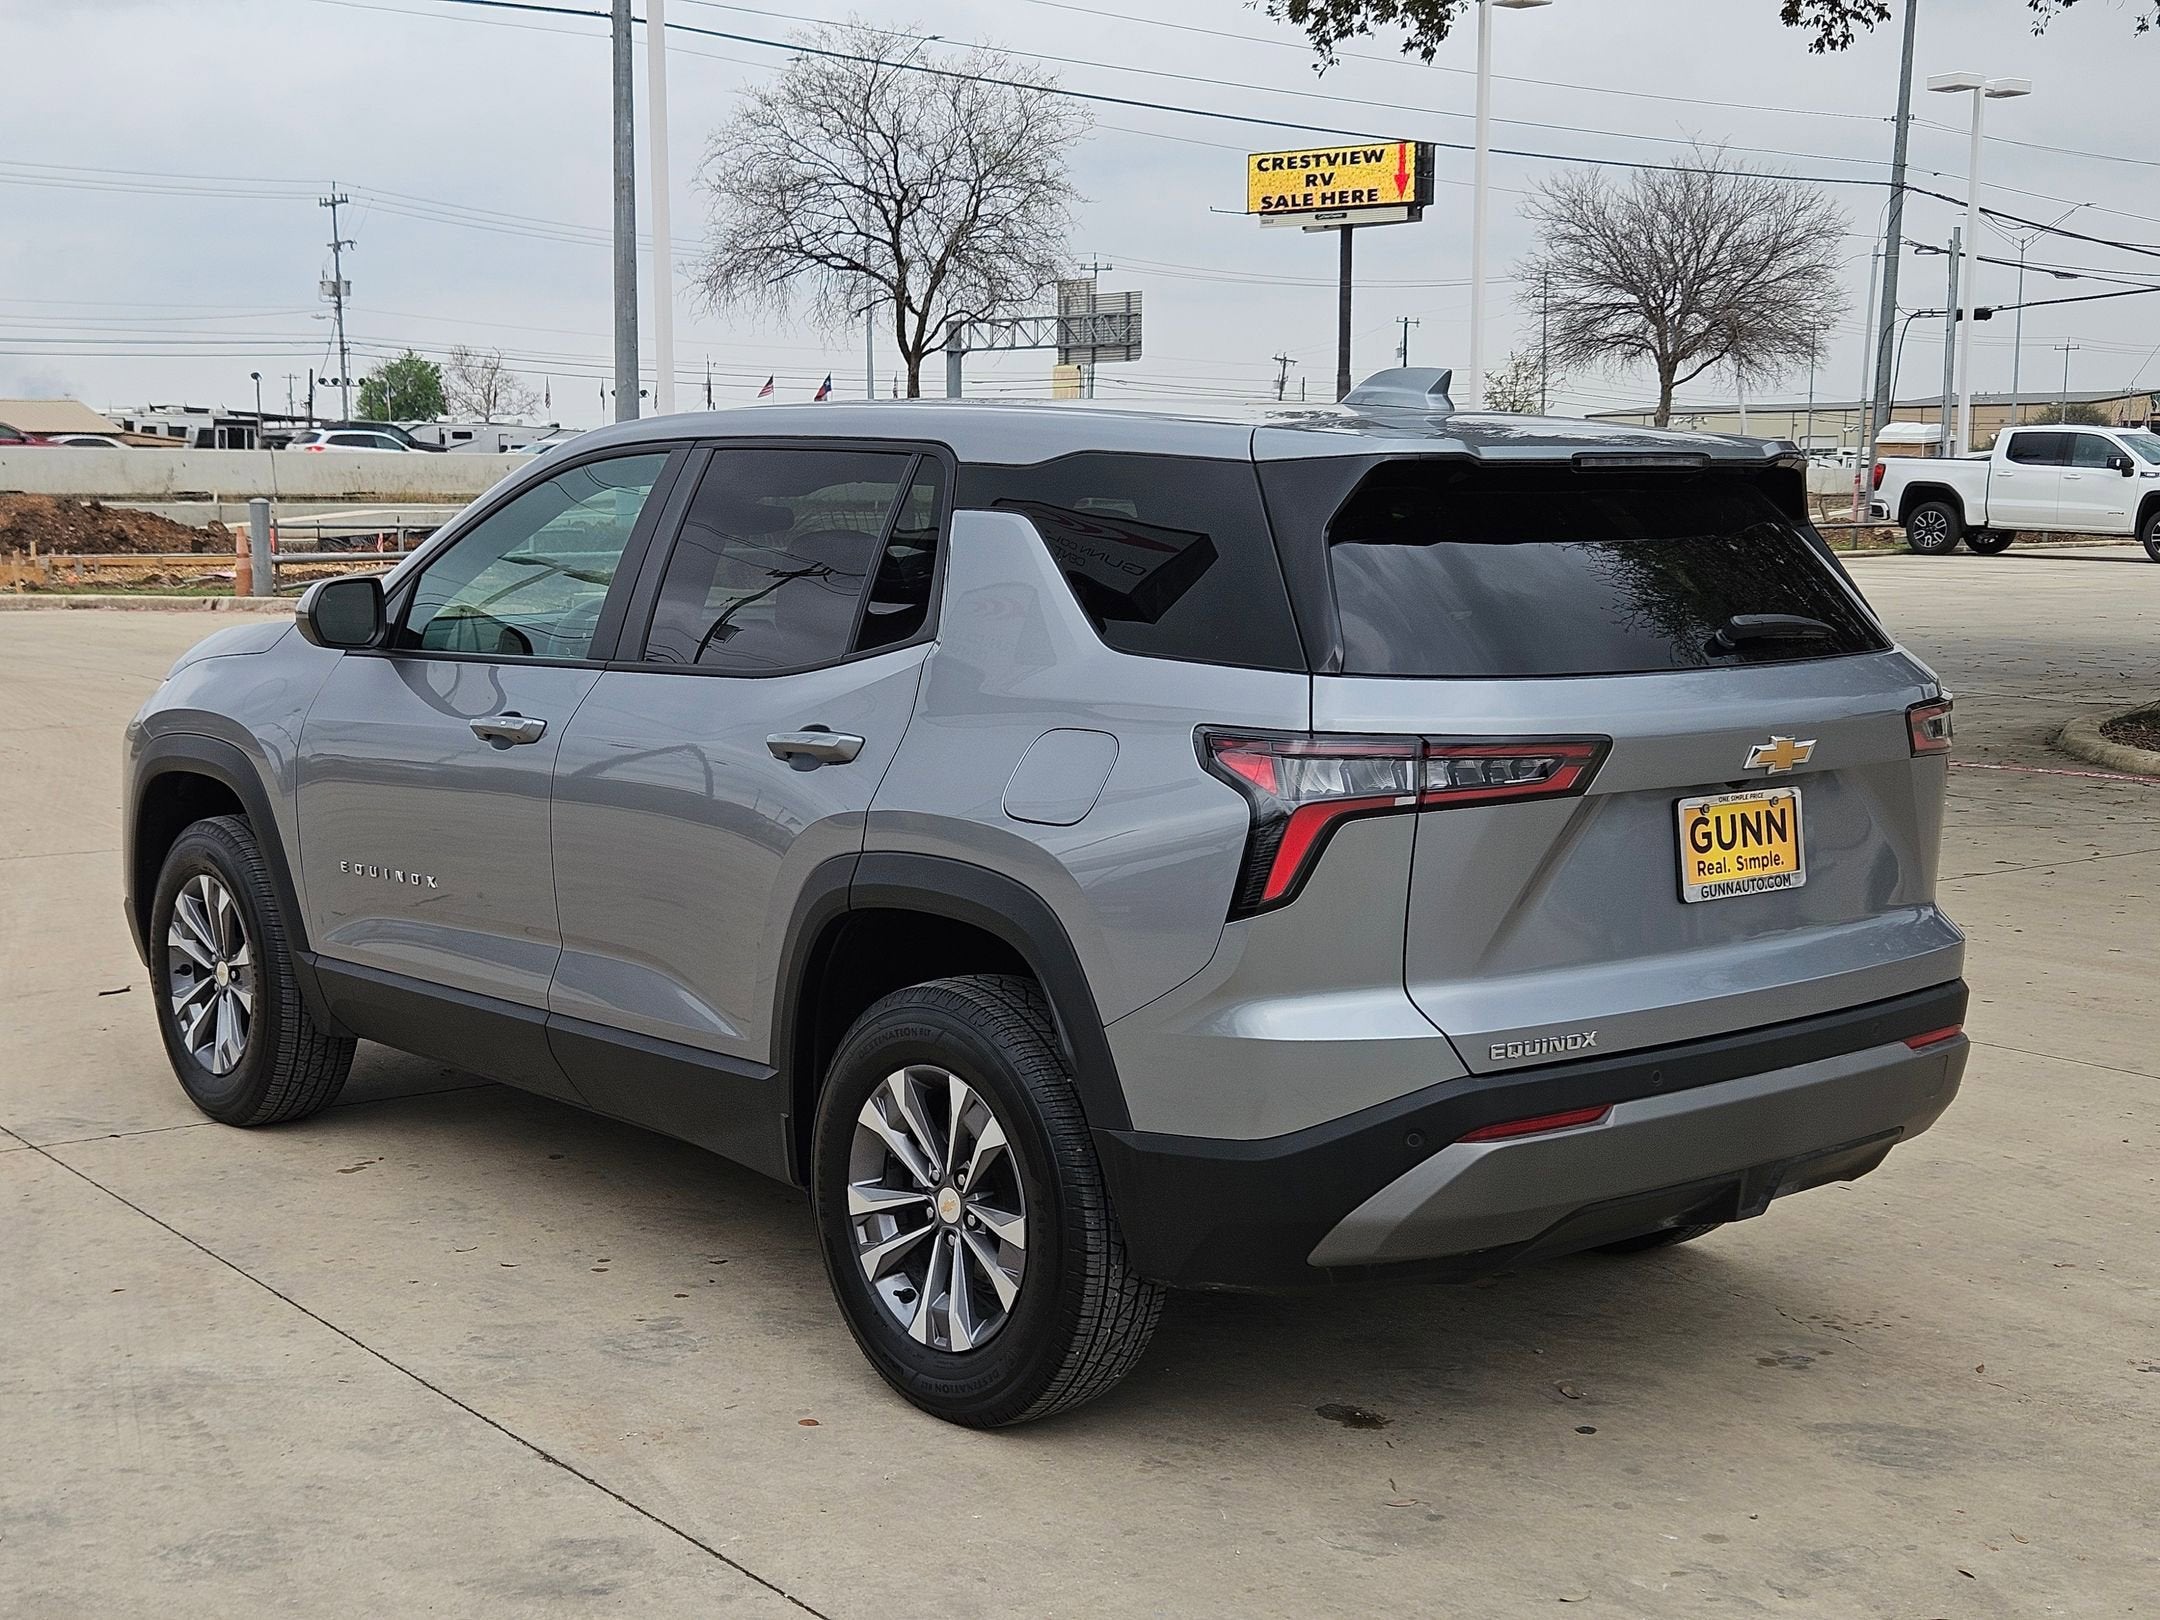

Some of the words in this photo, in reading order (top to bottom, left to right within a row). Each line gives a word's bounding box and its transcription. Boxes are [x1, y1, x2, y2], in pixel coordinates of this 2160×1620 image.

[1257, 149, 1385, 172] CRESTVIEW
[1305, 172, 1335, 188] RV
[1261, 193, 1314, 210] SALE
[1321, 188, 1378, 205] HERE
[1730, 793, 1749, 802] SIMPLE
[1690, 808, 1788, 854] GUNN
[340, 860, 438, 889] EQUINOX
[1697, 857, 1731, 877] Real.
[1701, 873, 1792, 898] GUNNAUTO.COM
[858, 1027, 918, 1059] DESTINATION
[1490, 1030, 1598, 1060] EQUINOX
